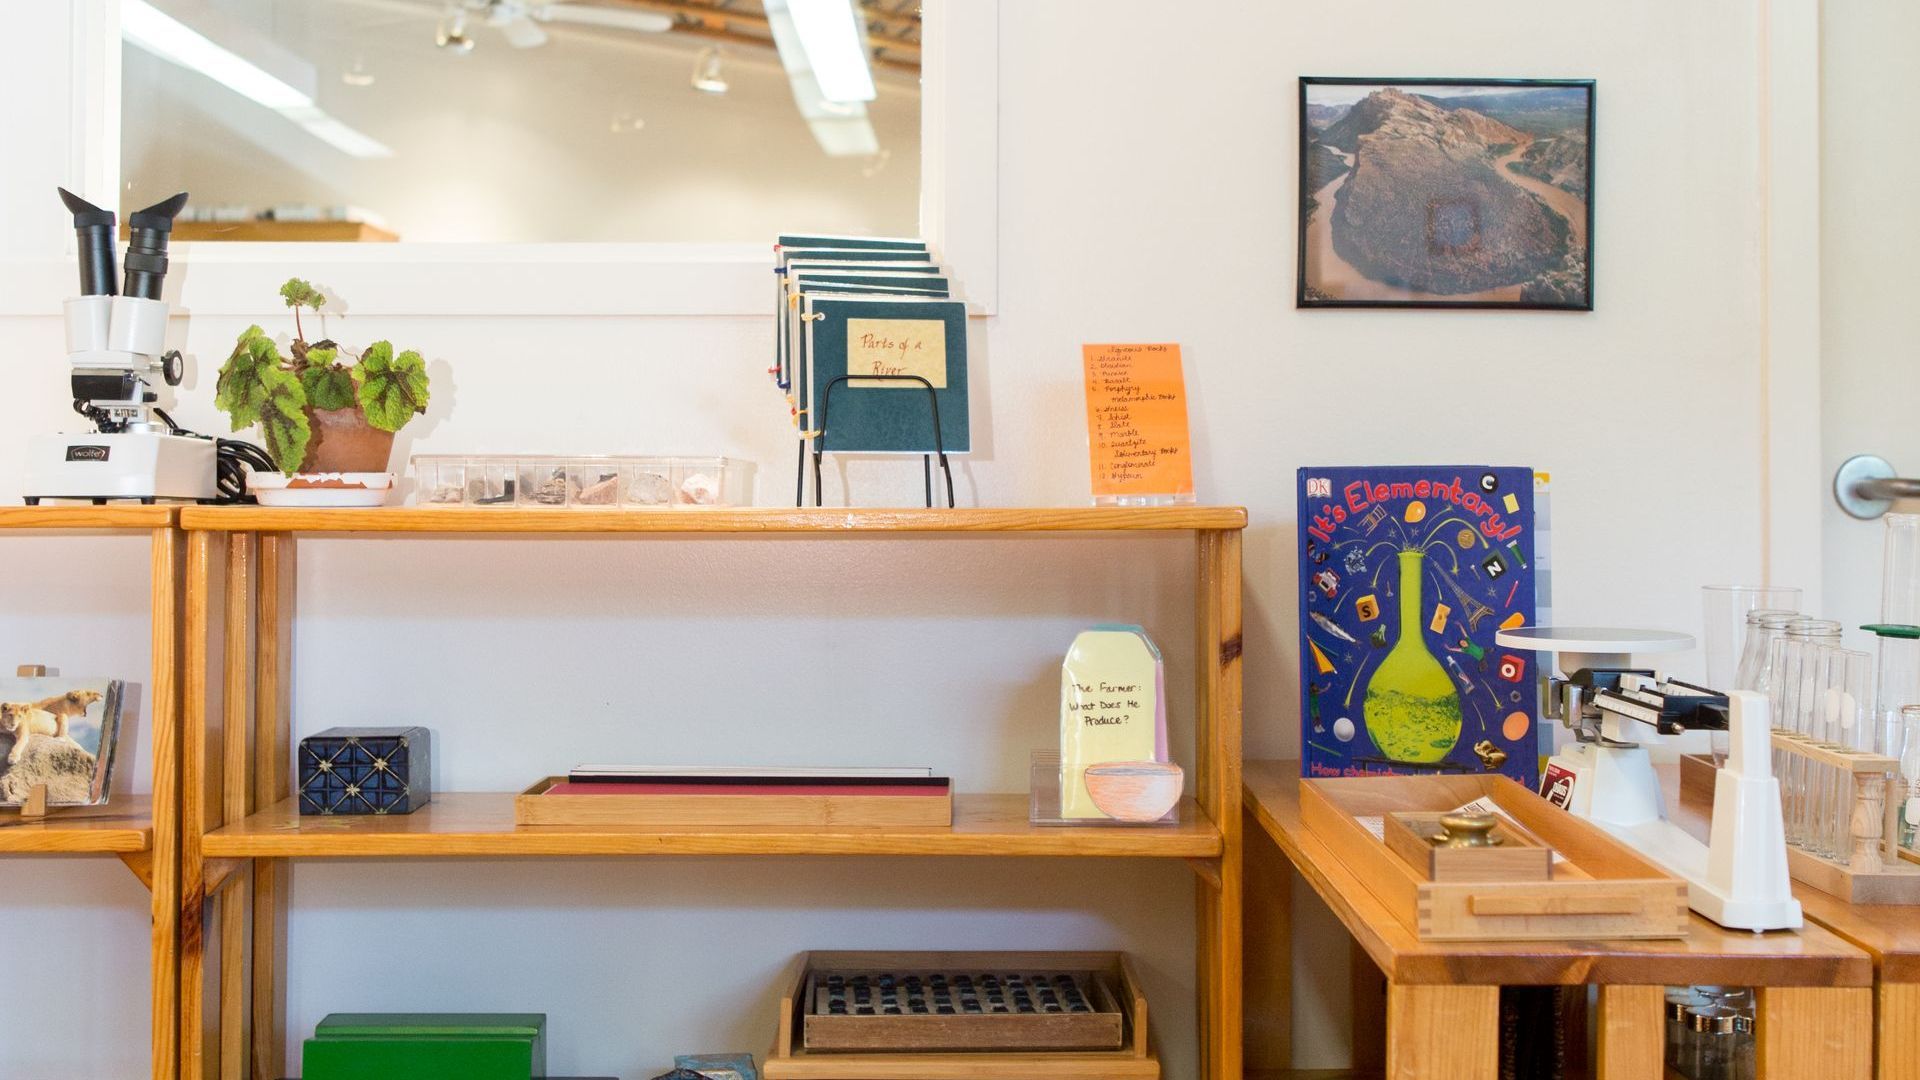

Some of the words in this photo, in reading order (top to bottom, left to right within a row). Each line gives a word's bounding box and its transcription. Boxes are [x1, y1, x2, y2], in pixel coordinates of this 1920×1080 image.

[860, 333, 894, 349] Parts
[899, 338, 908, 360] of
[915, 340, 922, 349] a
[872, 360, 907, 377] River
[1308, 479, 1330, 495] DK
[1480, 475, 1496, 490] C
[1308, 504, 1348, 543] It's
[1344, 477, 1522, 541] Elementary!
[1485, 559, 1503, 577] N
[1361, 605, 1372, 618] S
[1072, 683, 1093, 692] The
[1099, 682, 1142, 692] Farmer:
[1069, 702, 1096, 711] What
[1100, 701, 1121, 709] Does
[1127, 700, 1140, 708] He
[1084, 715, 1130, 726] Produce?
[1311, 761, 1341, 777] How
